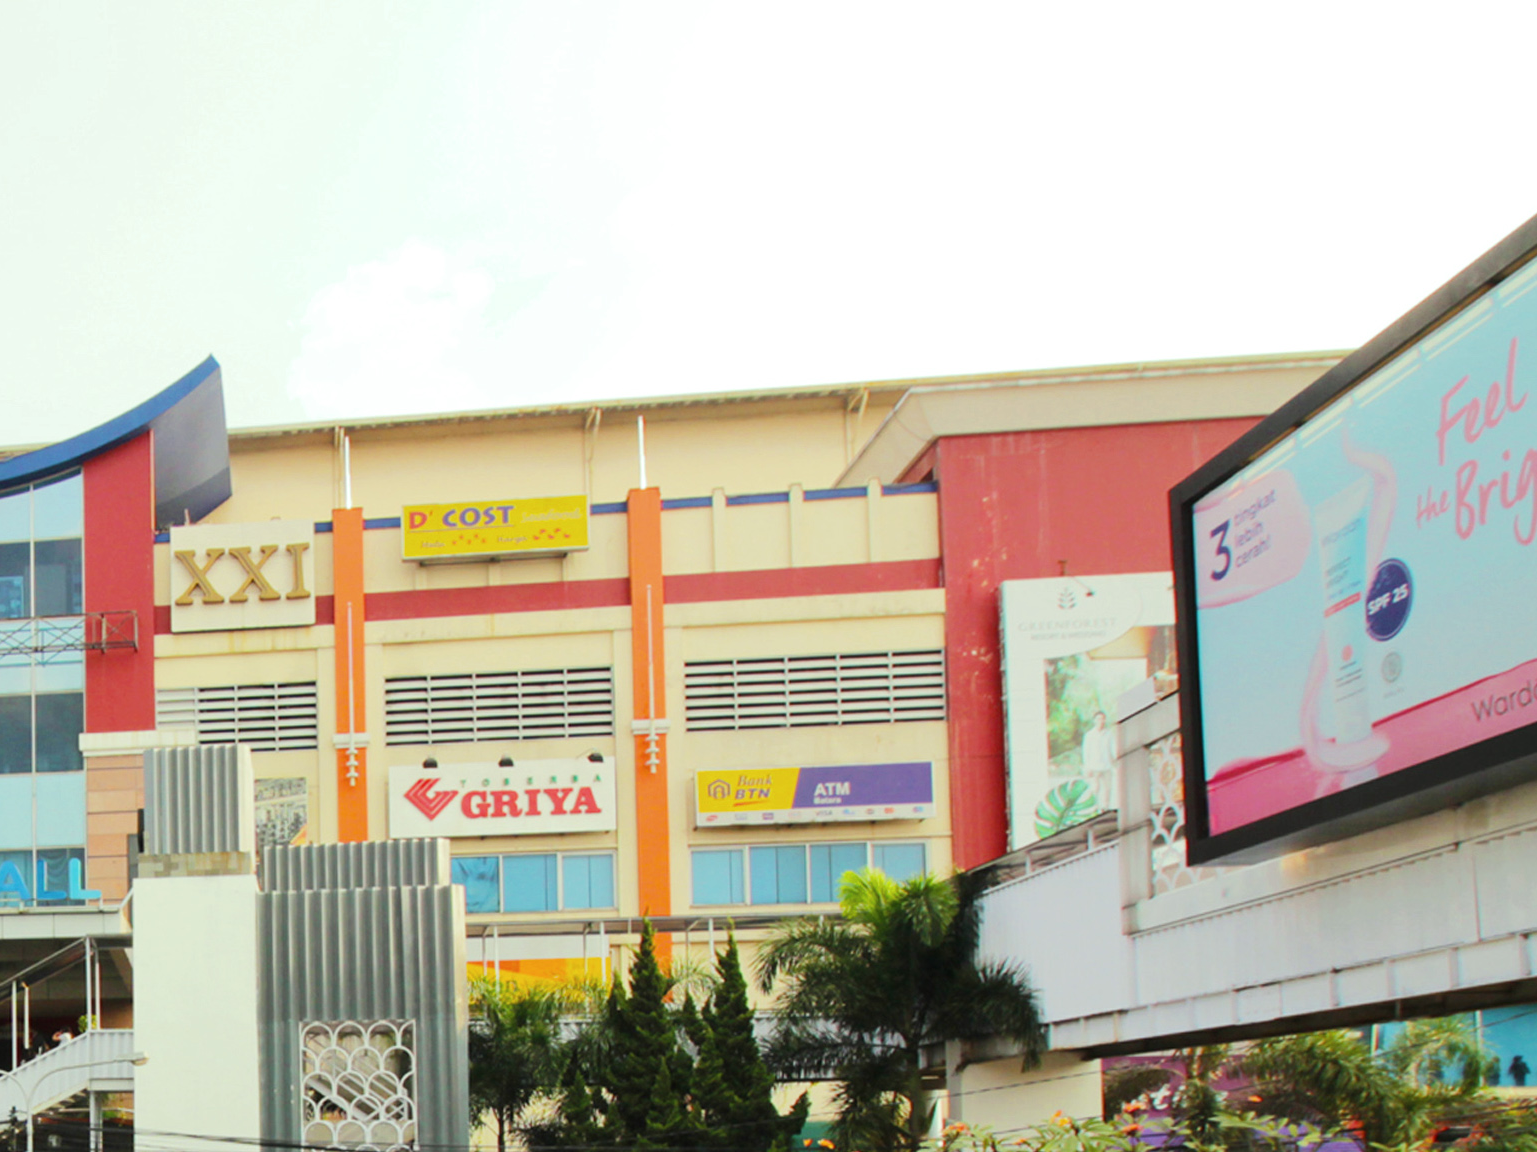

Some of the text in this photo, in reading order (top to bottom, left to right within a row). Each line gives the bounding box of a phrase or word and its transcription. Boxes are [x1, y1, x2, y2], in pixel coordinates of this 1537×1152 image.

[1435, 336, 1530, 467] Feel
[442, 505, 515, 528] COST
[1416, 485, 1452, 529] the
[1209, 518, 1232, 582] 3
[175, 541, 311, 606] XXI
[1367, 592, 1393, 616] SPF
[1470, 678, 1537, 723] Ward
[734, 787, 770, 800] BTN
[737, 775, 773, 787] Bank
[813, 781, 851, 796] ATM
[460, 786, 602, 820] GRIYA
